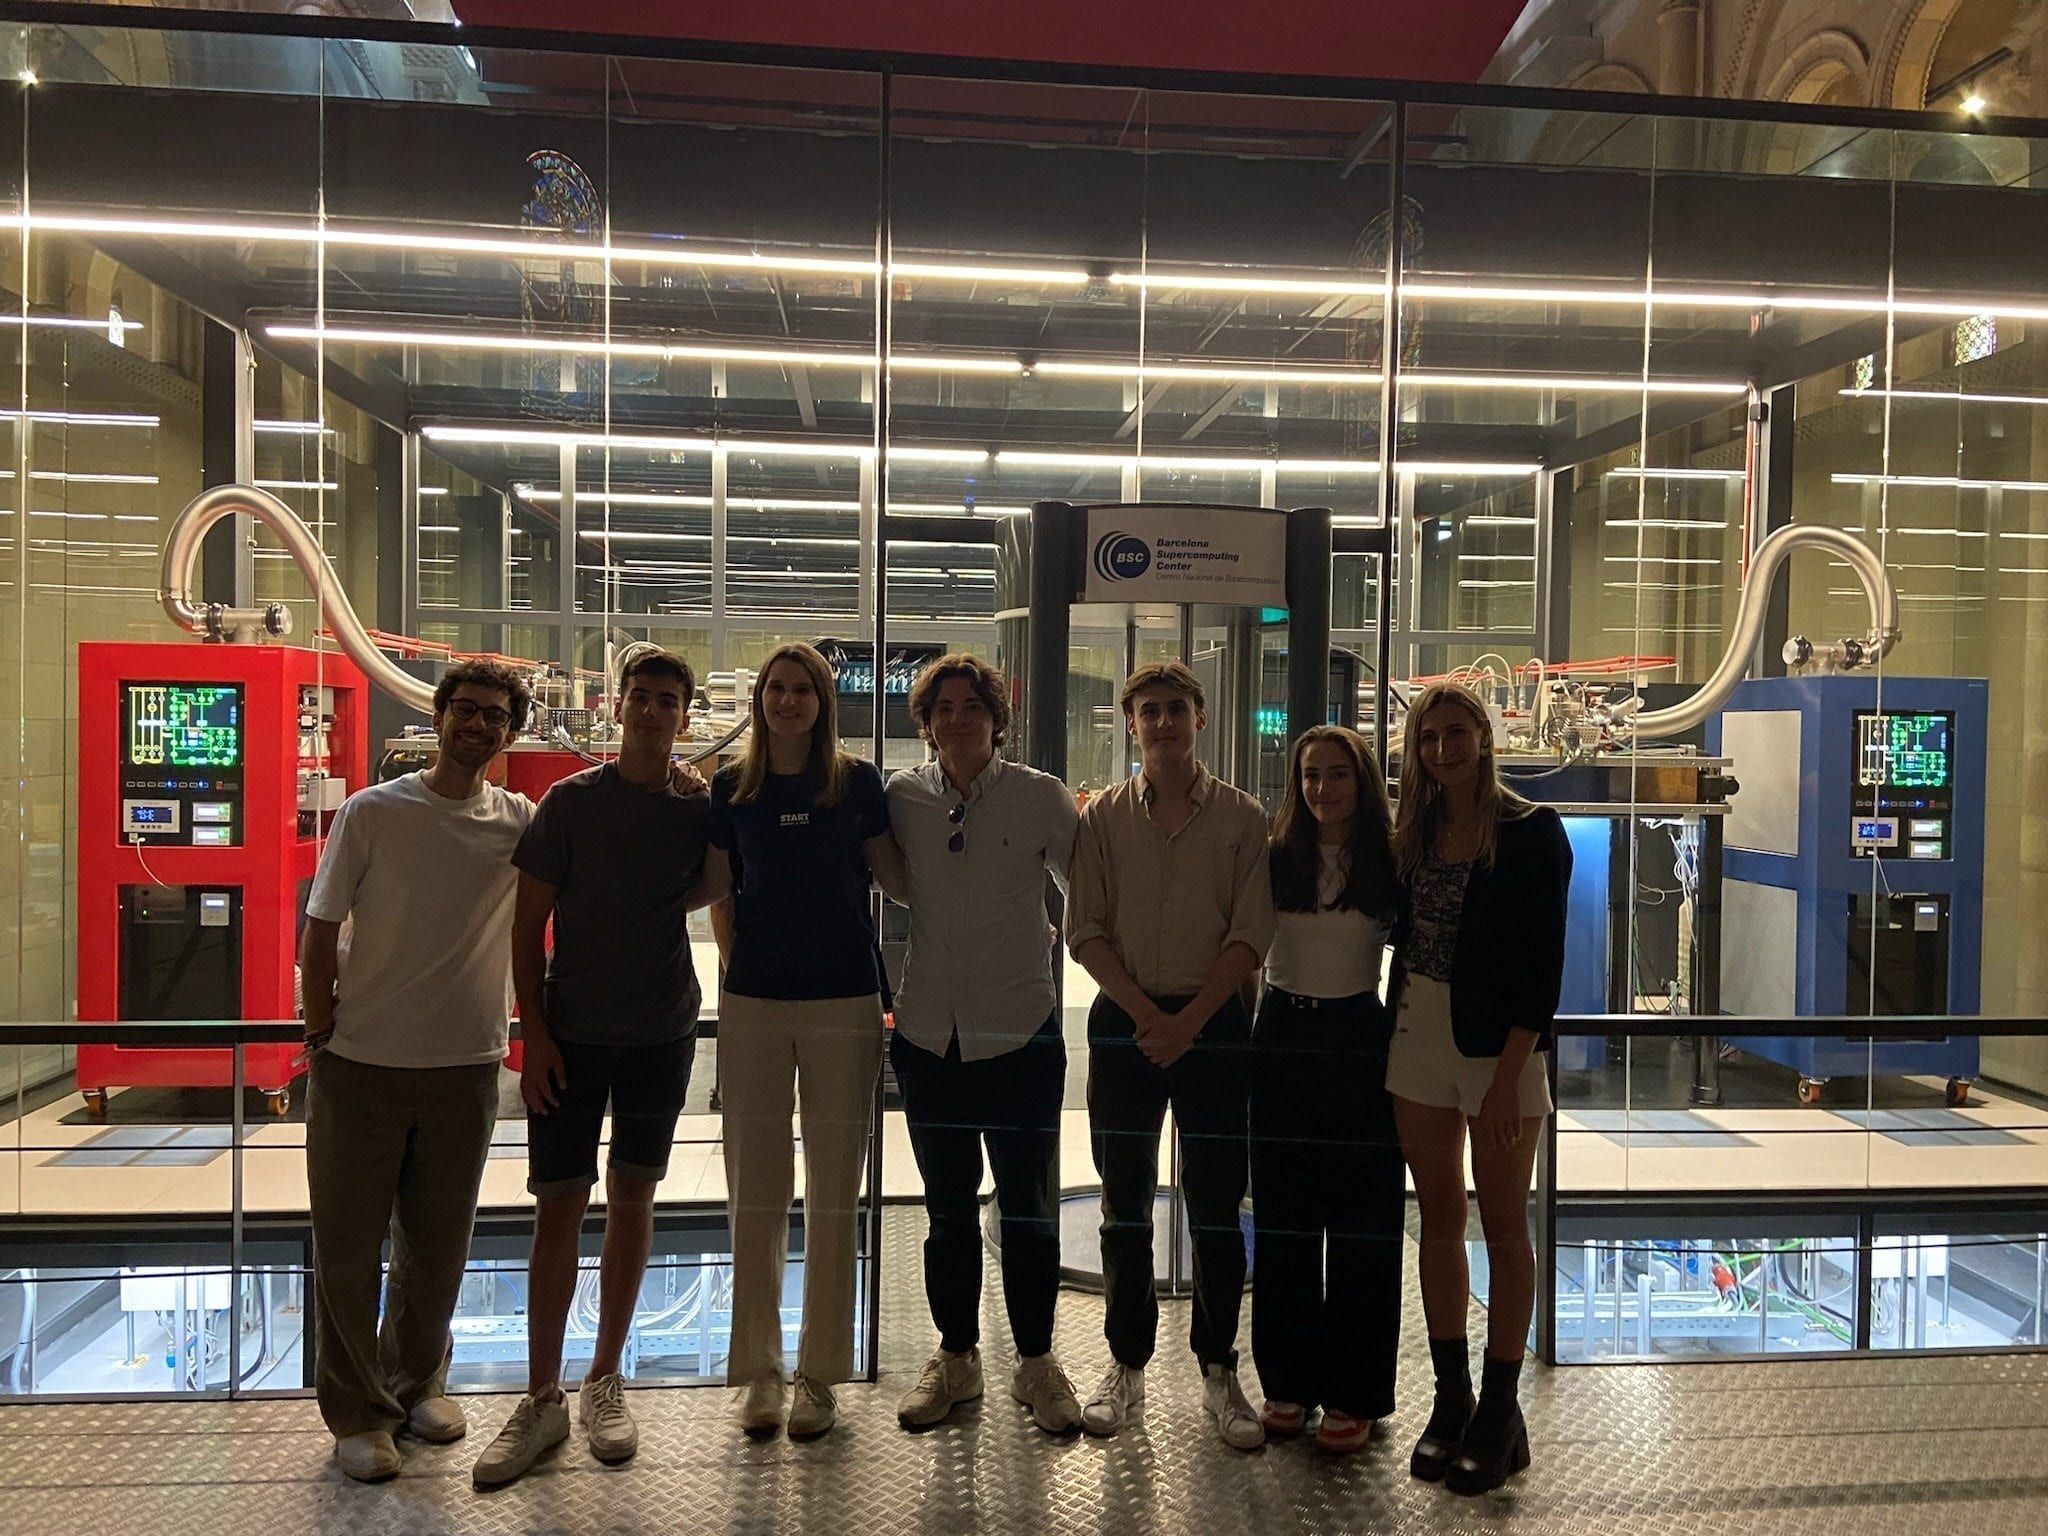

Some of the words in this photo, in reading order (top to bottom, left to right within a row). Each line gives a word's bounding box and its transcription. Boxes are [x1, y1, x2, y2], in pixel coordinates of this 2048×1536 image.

[1156, 538, 1210, 548] Barcelona
[1117, 552, 1145, 563] BSC
[1156, 550, 1239, 563] Supercomputing
[1156, 562, 1193, 571] Center
[780, 813, 809, 822] START
